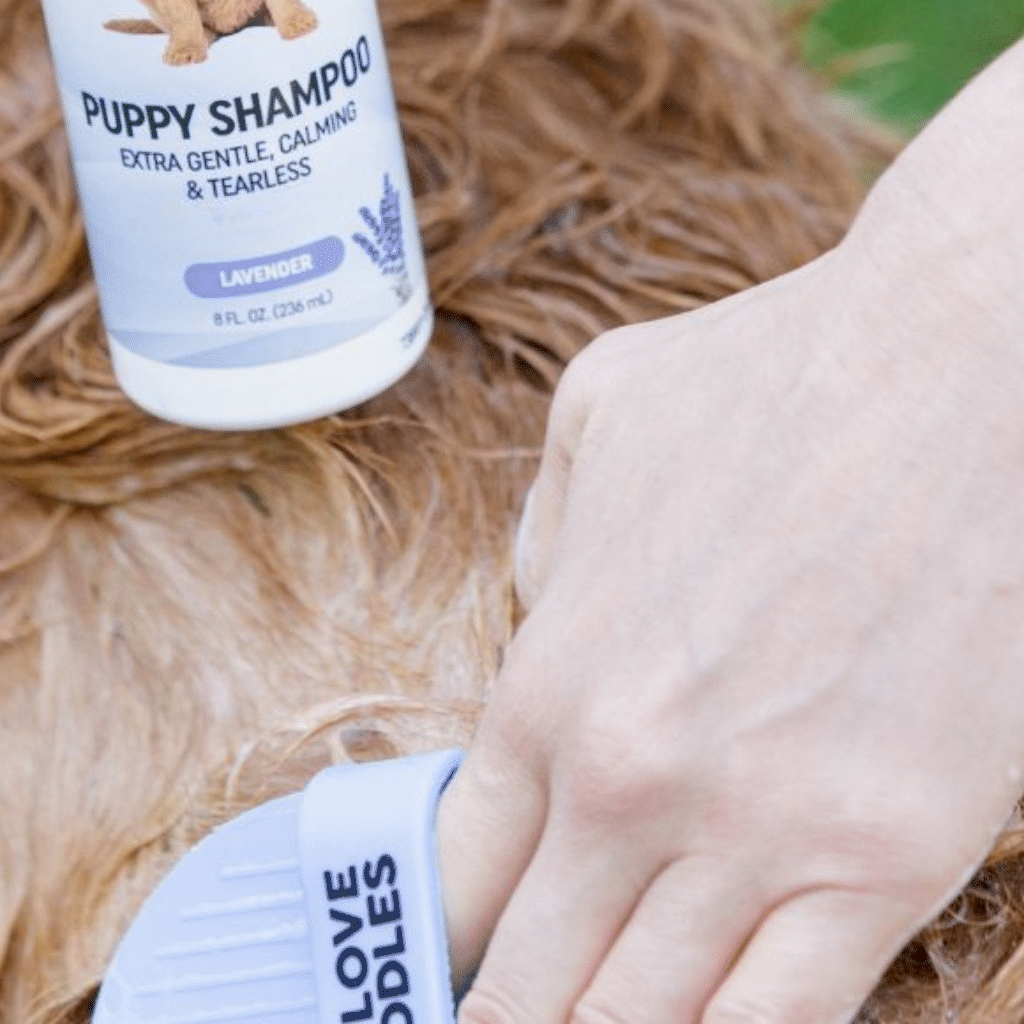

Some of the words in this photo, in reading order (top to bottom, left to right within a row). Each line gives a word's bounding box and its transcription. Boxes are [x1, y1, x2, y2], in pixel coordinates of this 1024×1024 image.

[81, 91, 195, 140] PUPPY
[208, 35, 371, 136] SHAMPOO
[120, 147, 183, 173] EXTRA
[186, 140, 275, 172] GENTLE,
[278, 100, 358, 154] CALMING
[187, 179, 204, 201] &
[208, 157, 312, 199] TEARLESS
[219, 253, 313, 288] LAVENDER
[213, 312, 224, 326] 8
[272, 300, 304, 321] (236
[324, 865, 374, 1024] LOVE
